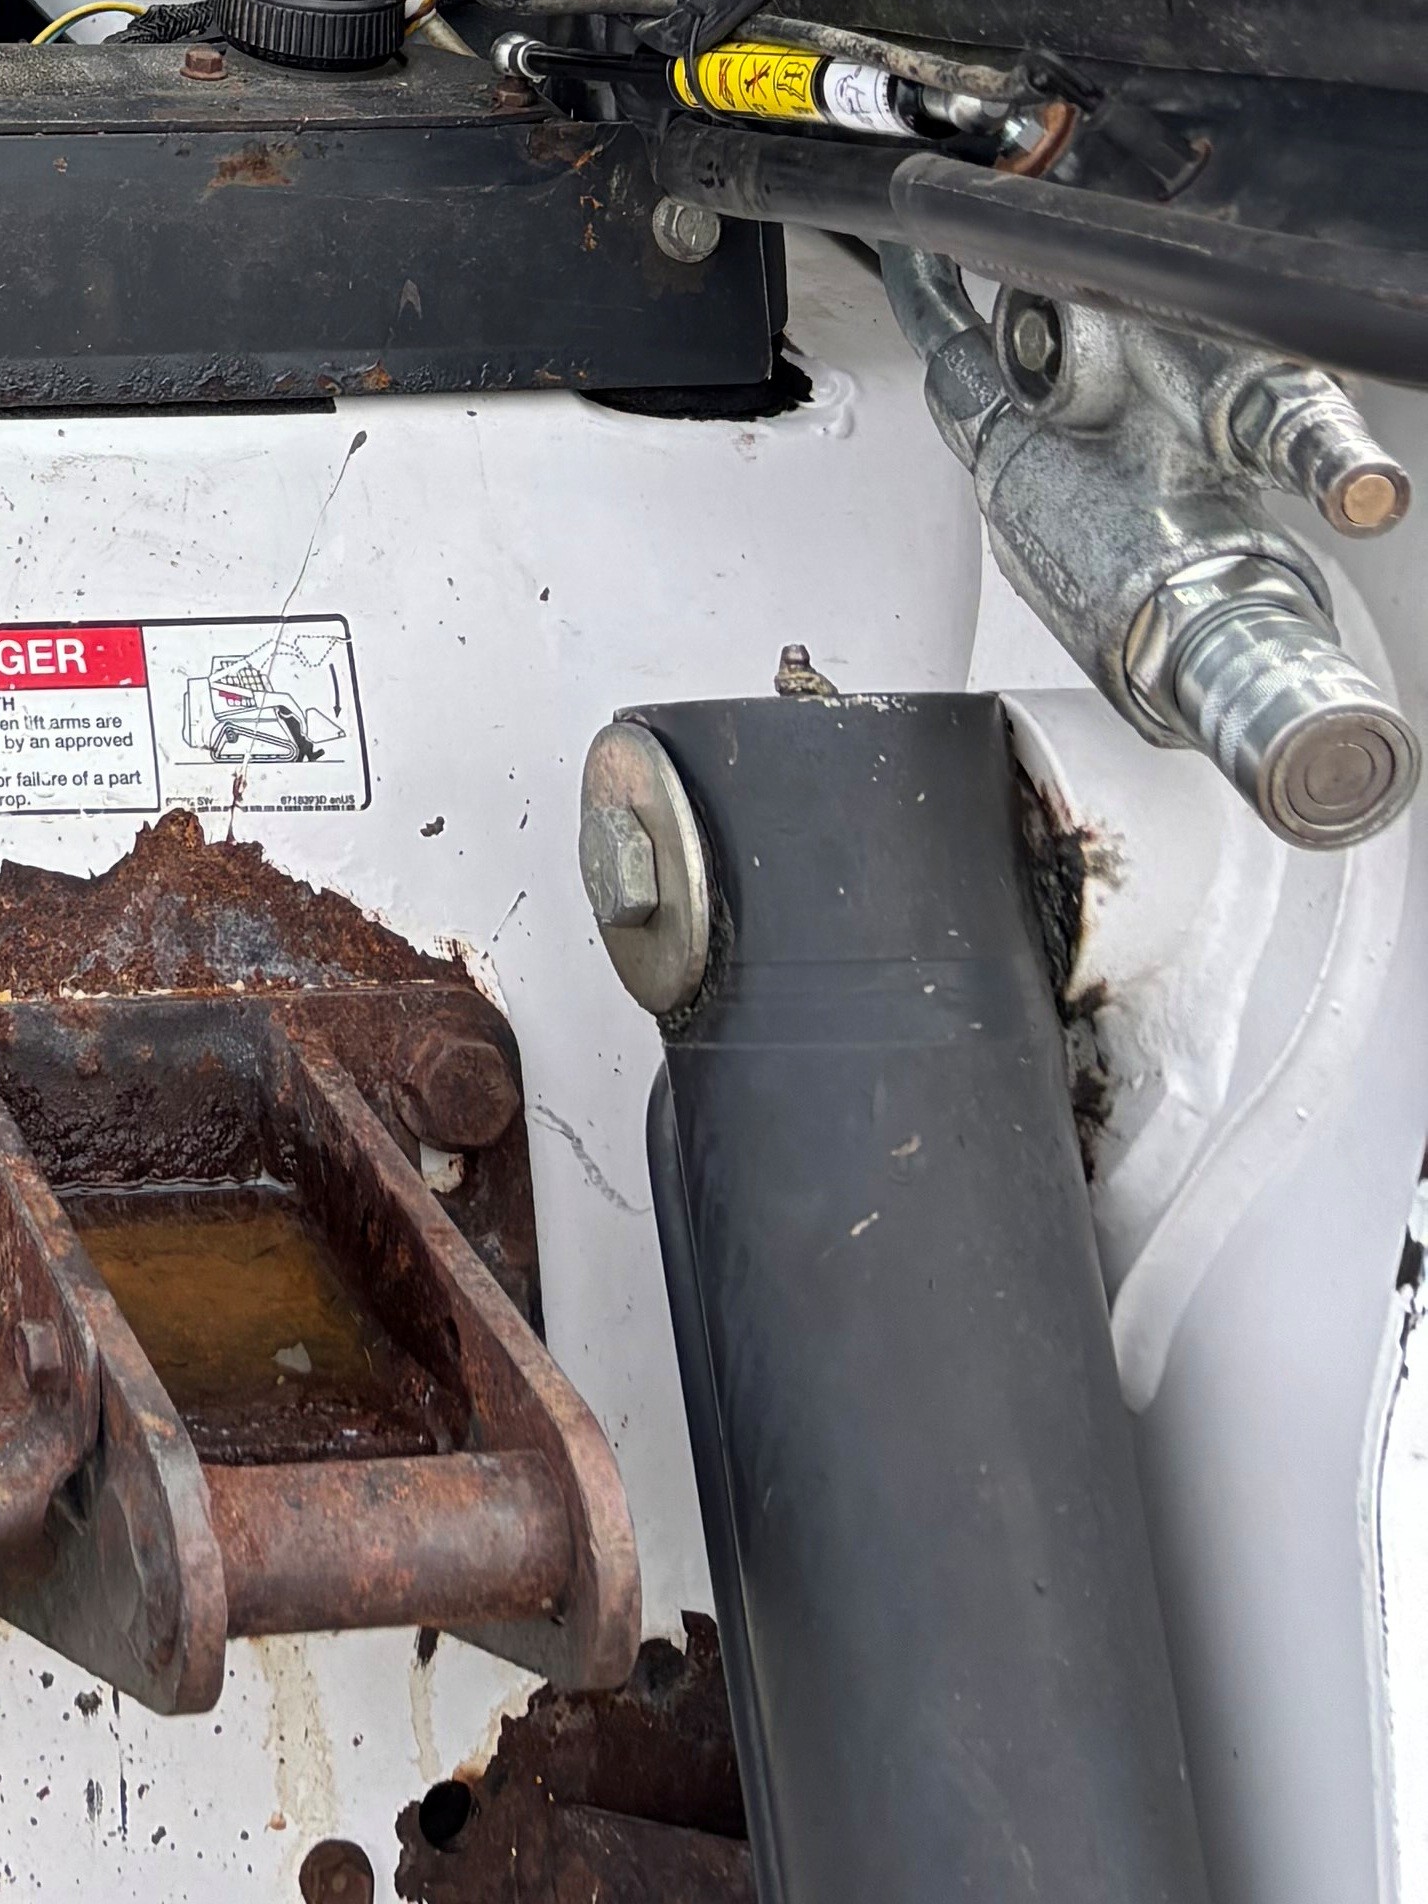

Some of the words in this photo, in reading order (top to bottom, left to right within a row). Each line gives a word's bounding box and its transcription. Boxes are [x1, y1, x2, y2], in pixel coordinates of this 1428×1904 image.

[50, 717, 90, 729] arms
[97, 716, 121, 728] are
[5, 736, 24, 752] by
[30, 737, 49, 748] an
[55, 732, 133, 750] approved
[73, 771, 88, 785] of
[94, 774, 103, 785] a
[109, 770, 141, 787] part
